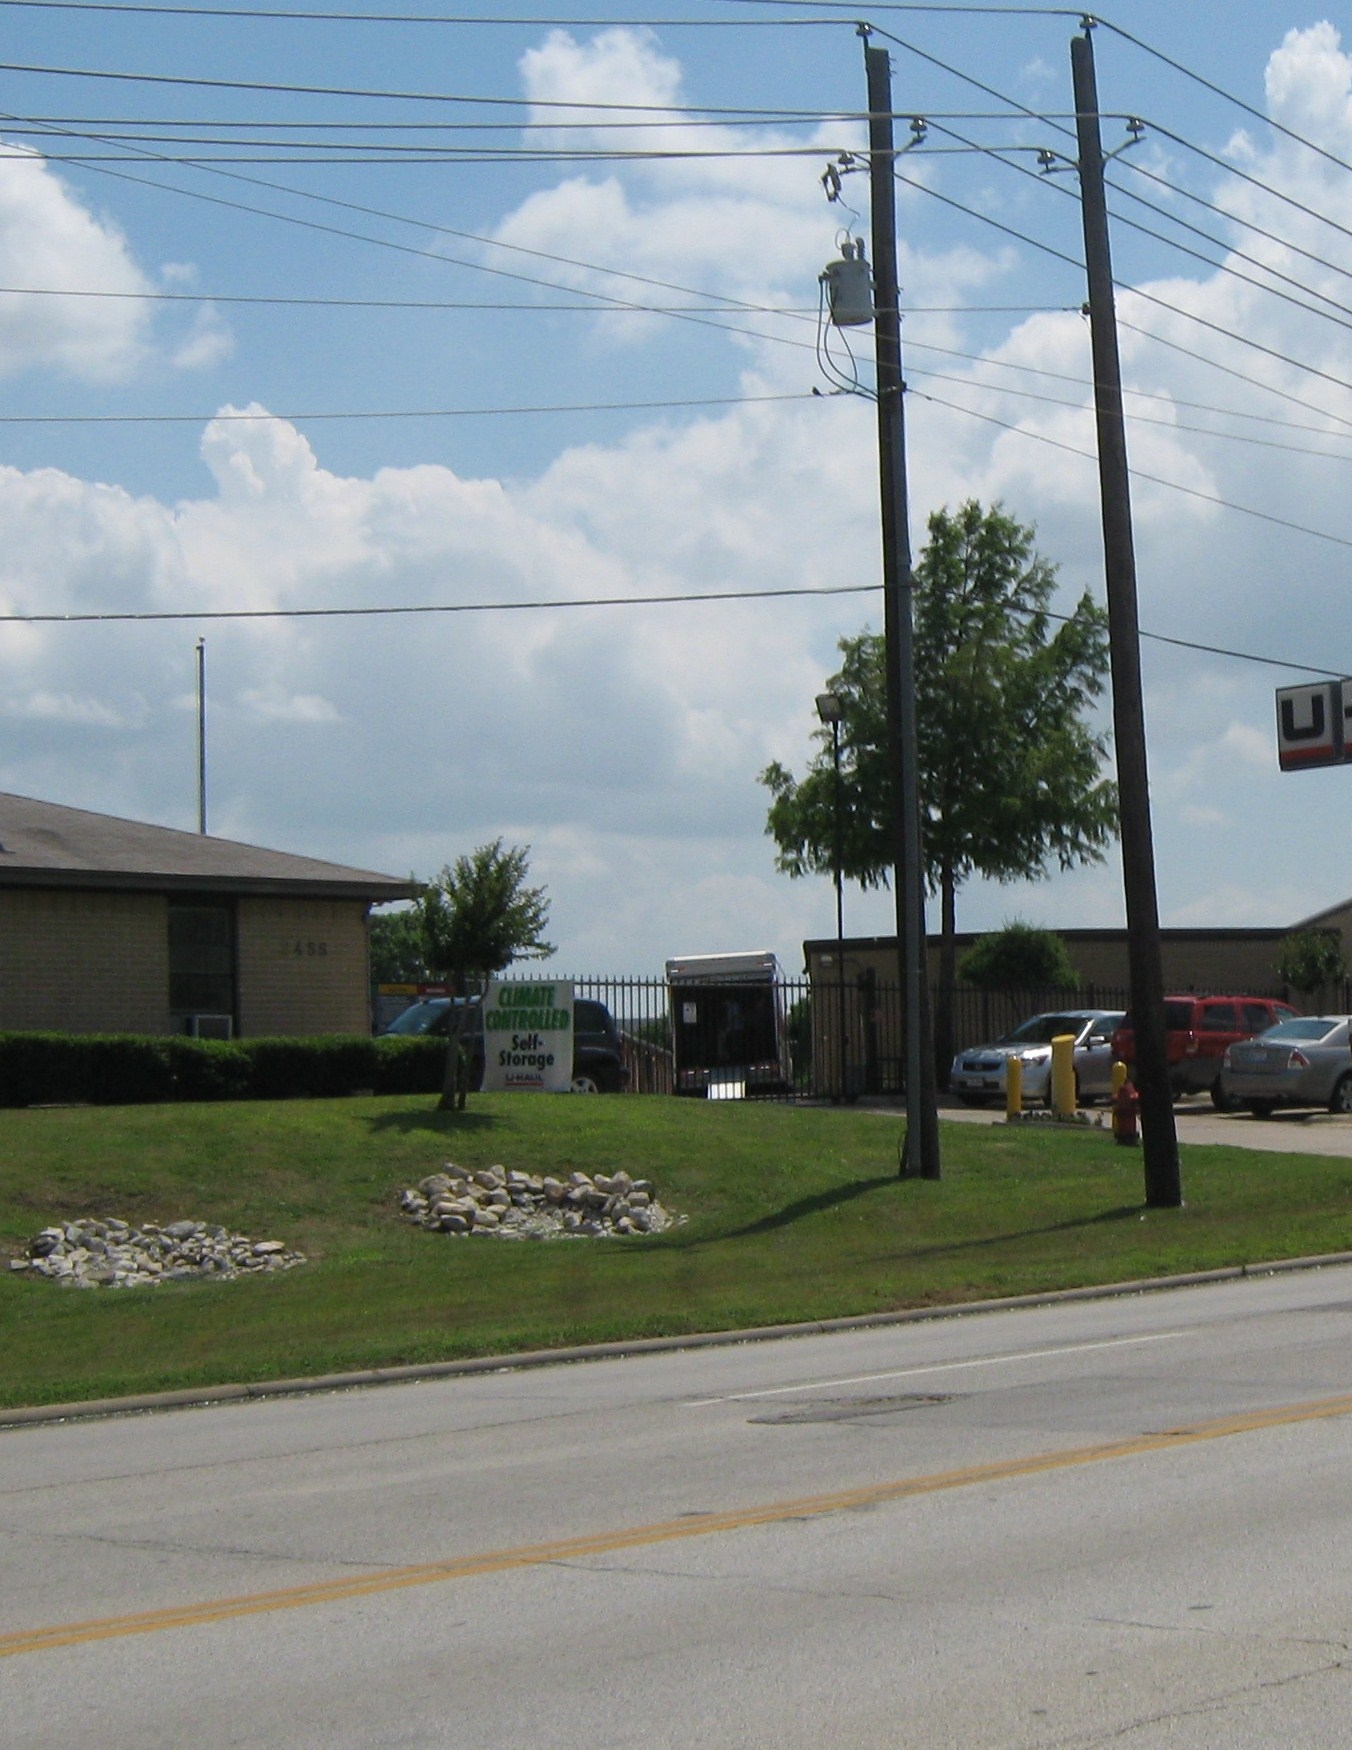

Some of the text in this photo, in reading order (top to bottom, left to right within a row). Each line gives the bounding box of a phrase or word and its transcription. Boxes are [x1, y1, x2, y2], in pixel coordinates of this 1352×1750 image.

[498, 985, 555, 1009] CLIMATE
[485, 1008, 570, 1031] CONTROLLED
[512, 1033, 544, 1051] Self-
[499, 1050, 555, 1071] Storage
